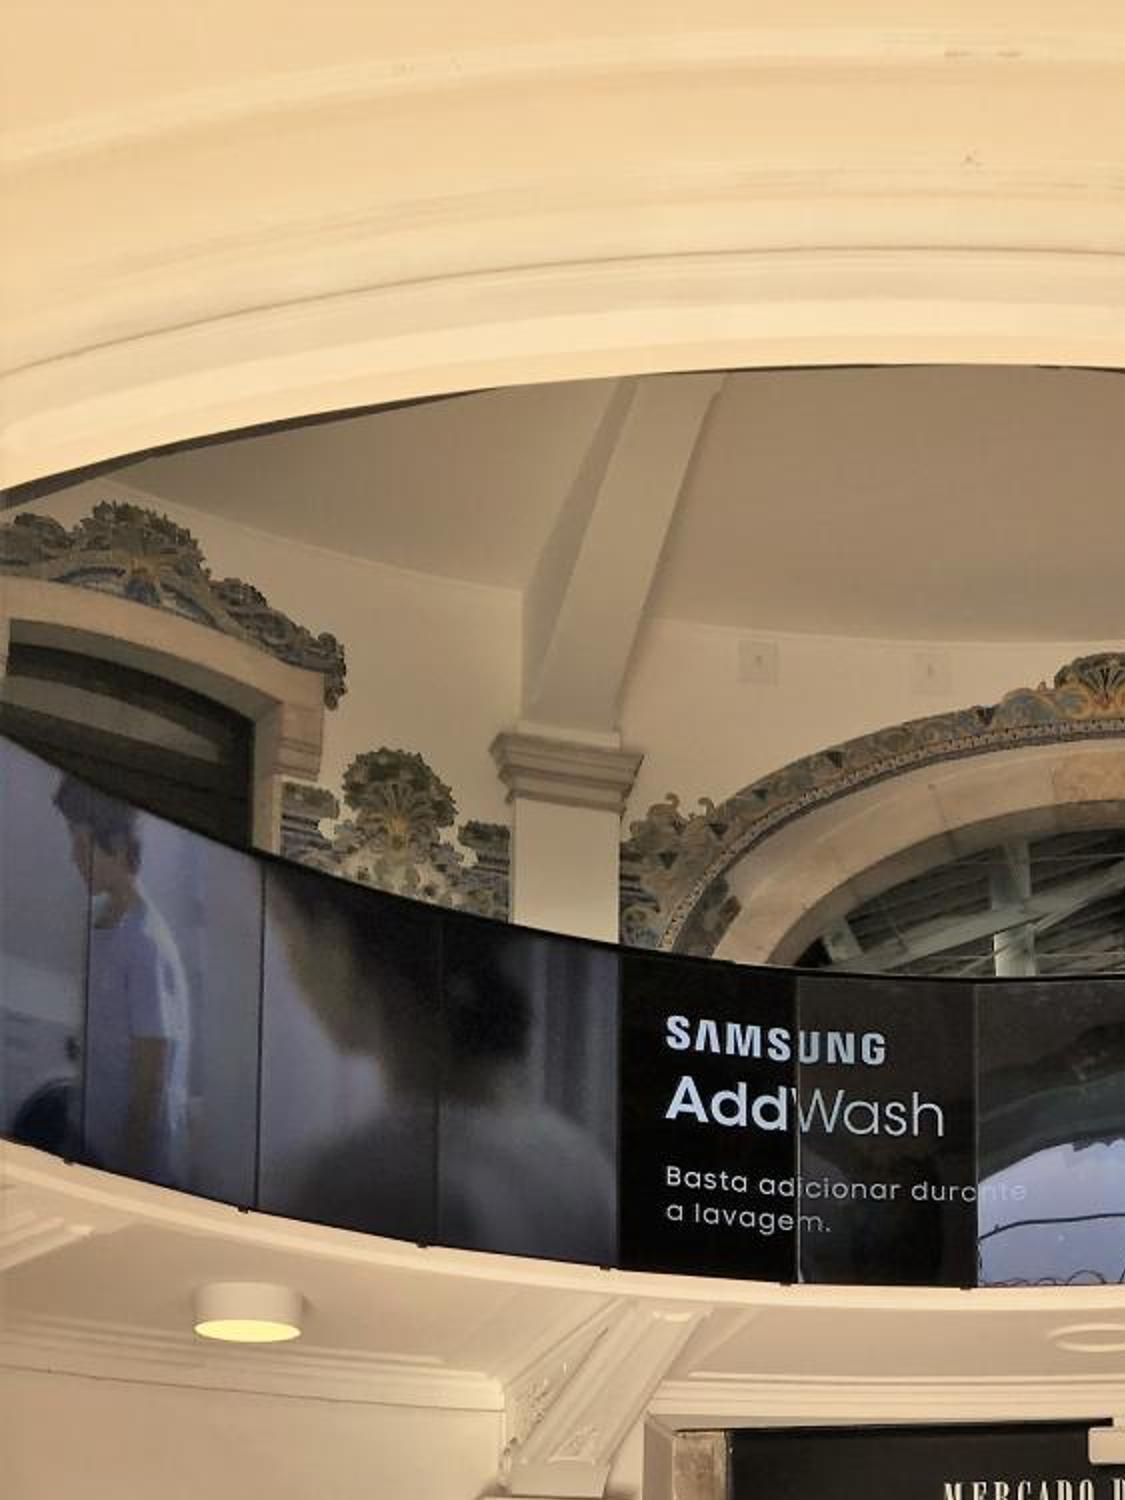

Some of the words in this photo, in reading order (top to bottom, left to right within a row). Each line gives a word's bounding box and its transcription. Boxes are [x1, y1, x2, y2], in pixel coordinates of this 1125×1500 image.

[665, 1014, 887, 1066] SAMSUNG
[664, 1074, 946, 1138] AddWash
[665, 1165, 749, 1194] Basta
[758, 1173, 900, 1203] adicionar
[665, 1204, 685, 1223] a
[694, 1203, 833, 1237] lavagem.
